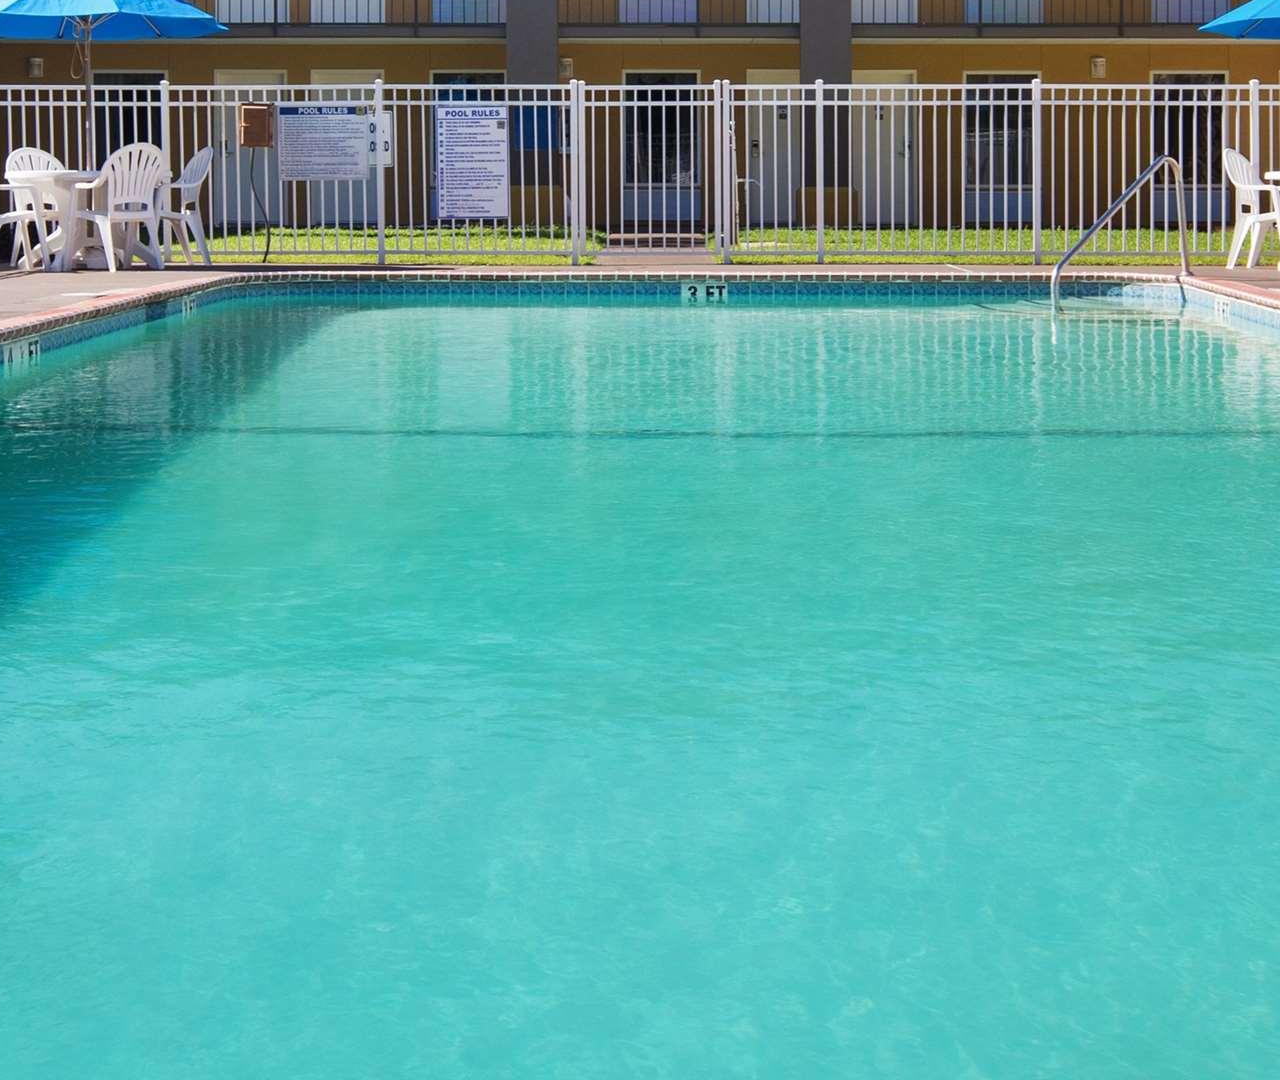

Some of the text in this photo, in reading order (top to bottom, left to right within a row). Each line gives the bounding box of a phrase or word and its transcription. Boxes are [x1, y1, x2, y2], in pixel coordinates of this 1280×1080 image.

[298, 107, 348, 115] POOL RULES
[445, 109, 500, 118] POOL RULES
